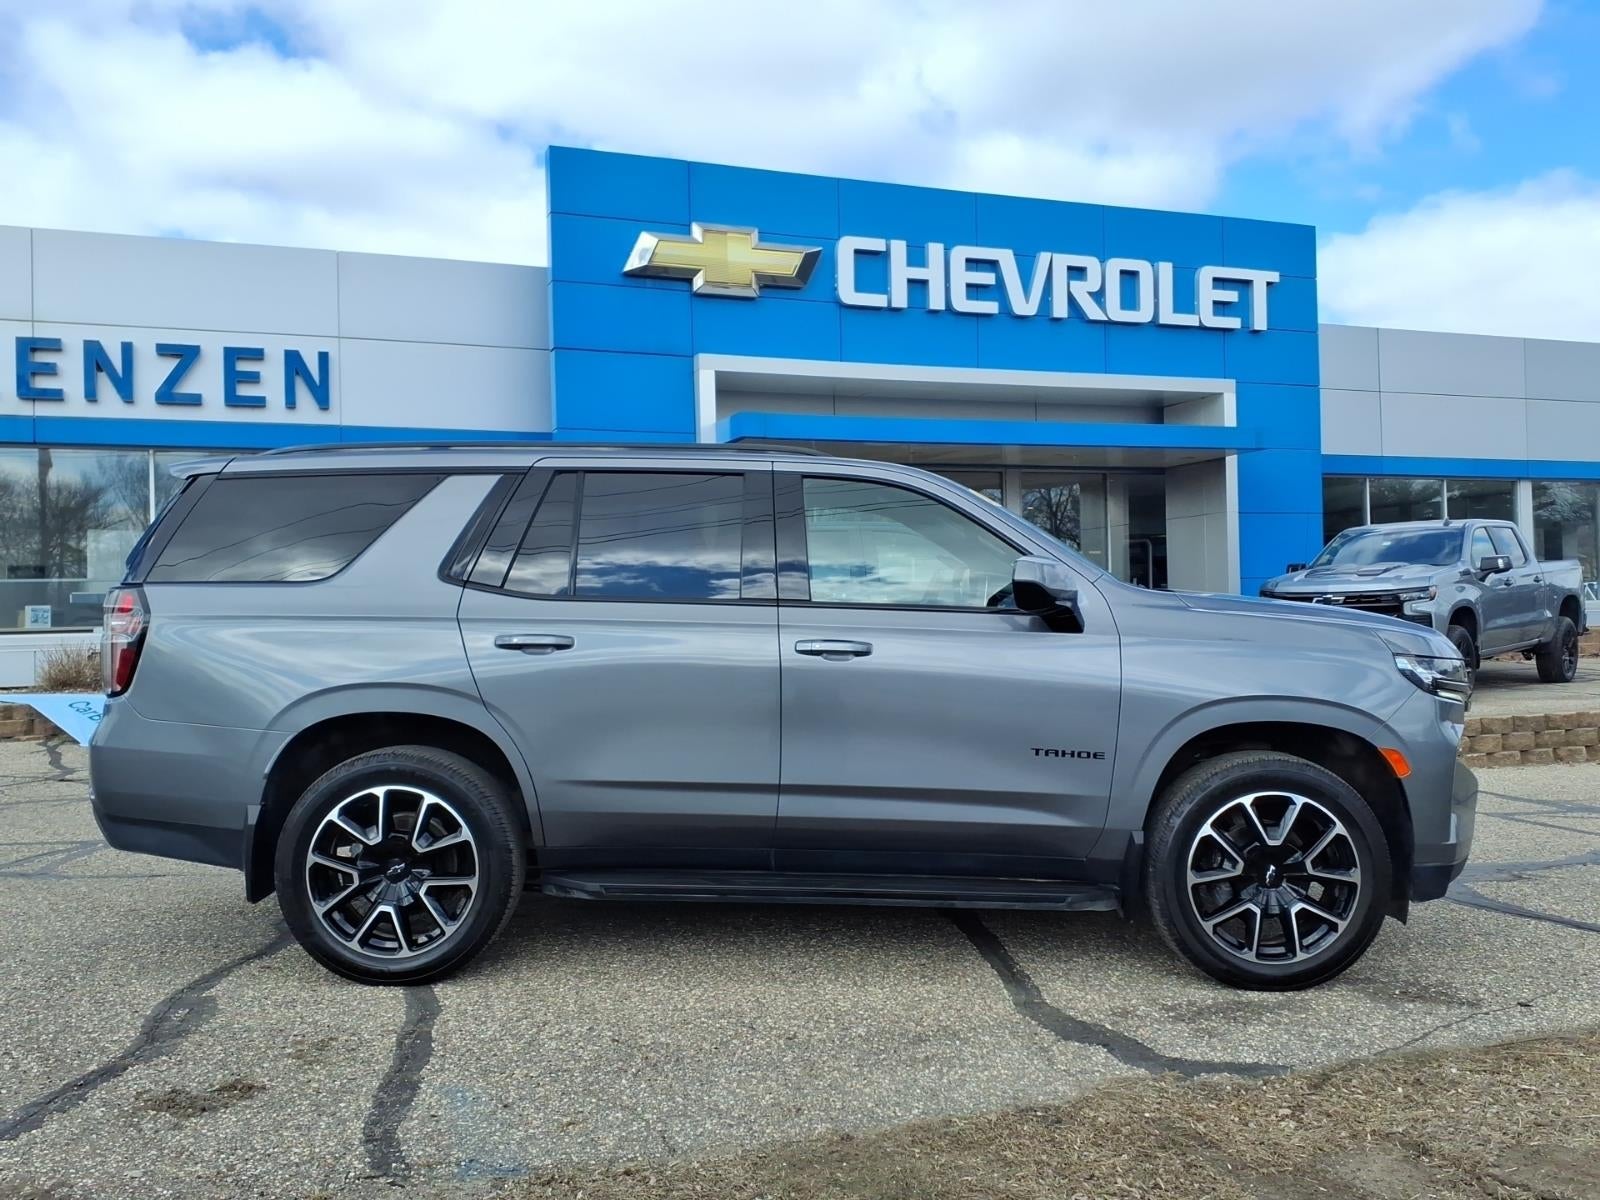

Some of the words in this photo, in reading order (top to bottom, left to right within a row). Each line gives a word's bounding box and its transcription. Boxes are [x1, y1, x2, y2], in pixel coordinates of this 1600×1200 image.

[835, 235, 1280, 331] CHEVROLET
[15, 336, 330, 410] ENZEN
[68, 701, 102, 721] Carb
[1030, 747, 1106, 760] TAHOE
